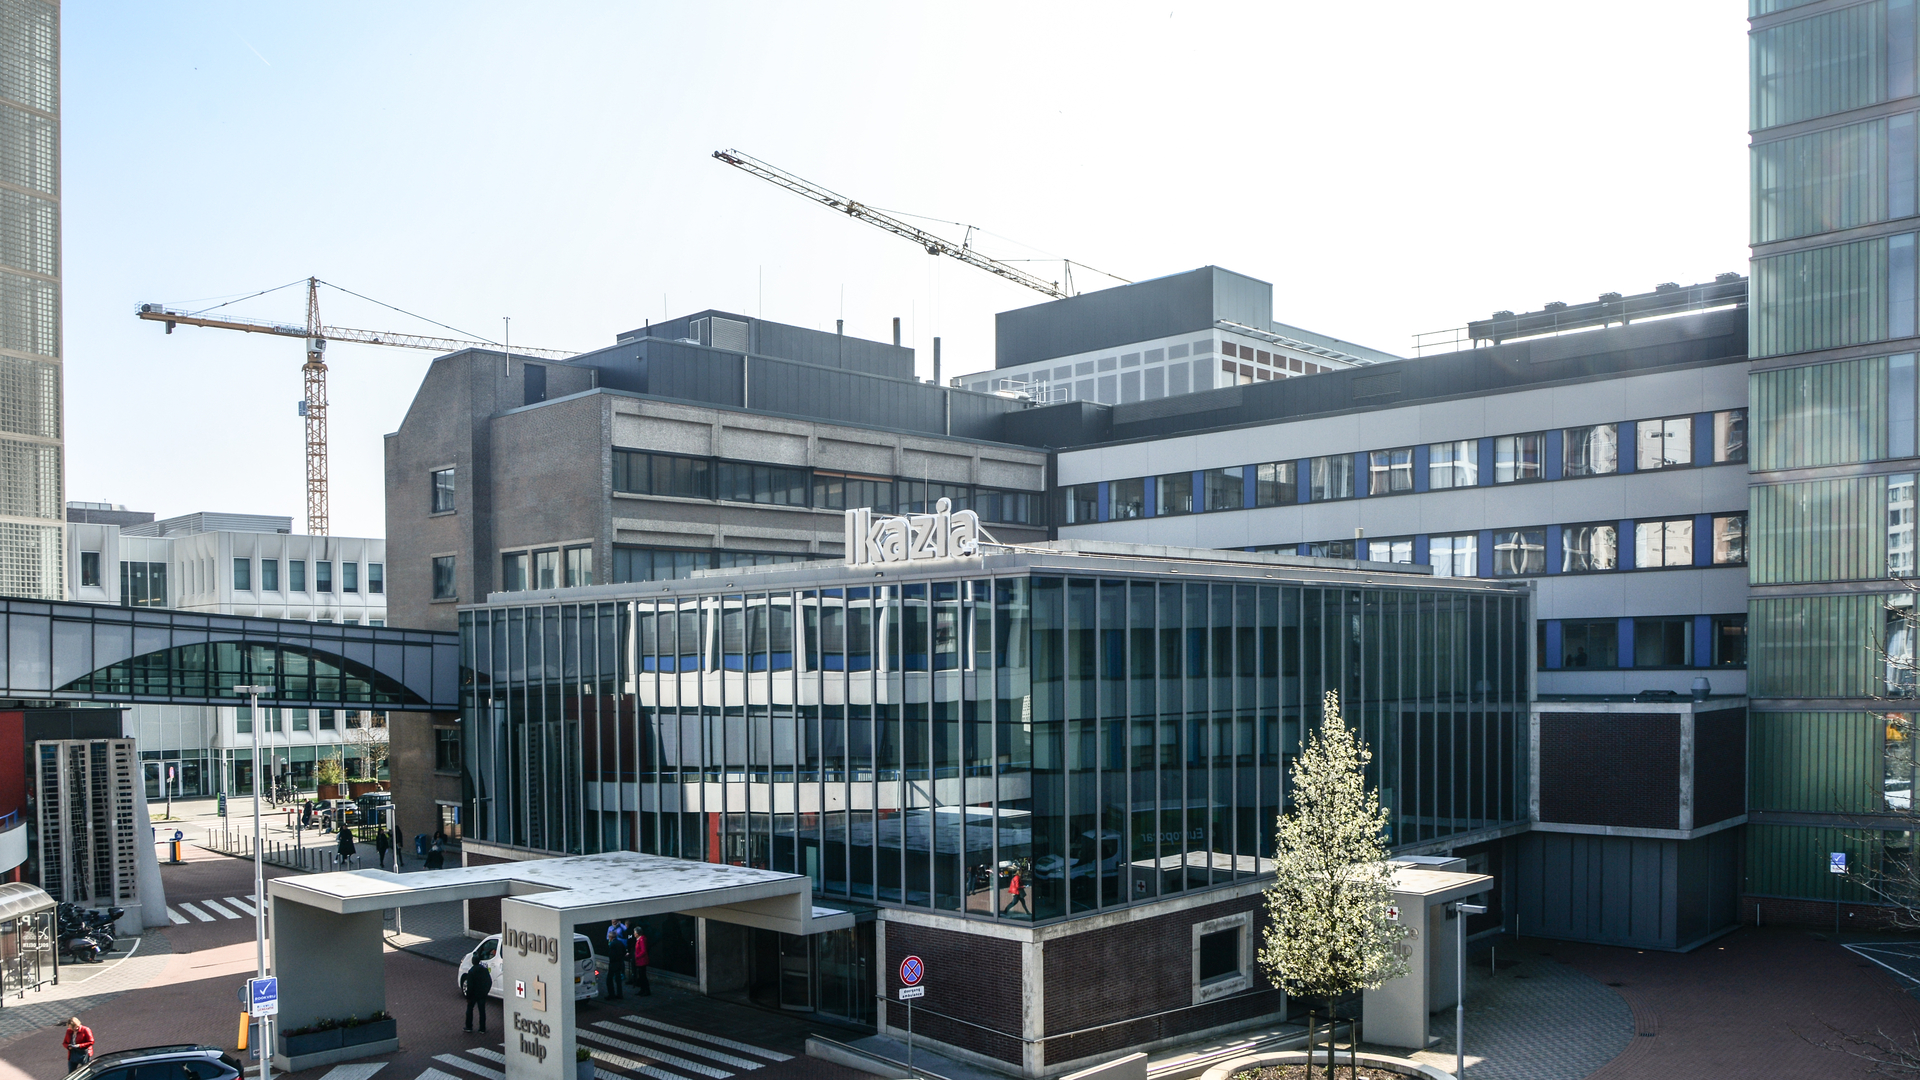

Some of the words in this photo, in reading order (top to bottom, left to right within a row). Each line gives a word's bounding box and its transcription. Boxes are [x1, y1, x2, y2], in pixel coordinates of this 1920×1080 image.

[845, 497, 979, 567] Ikazia
[502, 921, 558, 964] Ingang
[514, 1011, 550, 1039] Eerste
[520, 1033, 547, 1064] hulp
